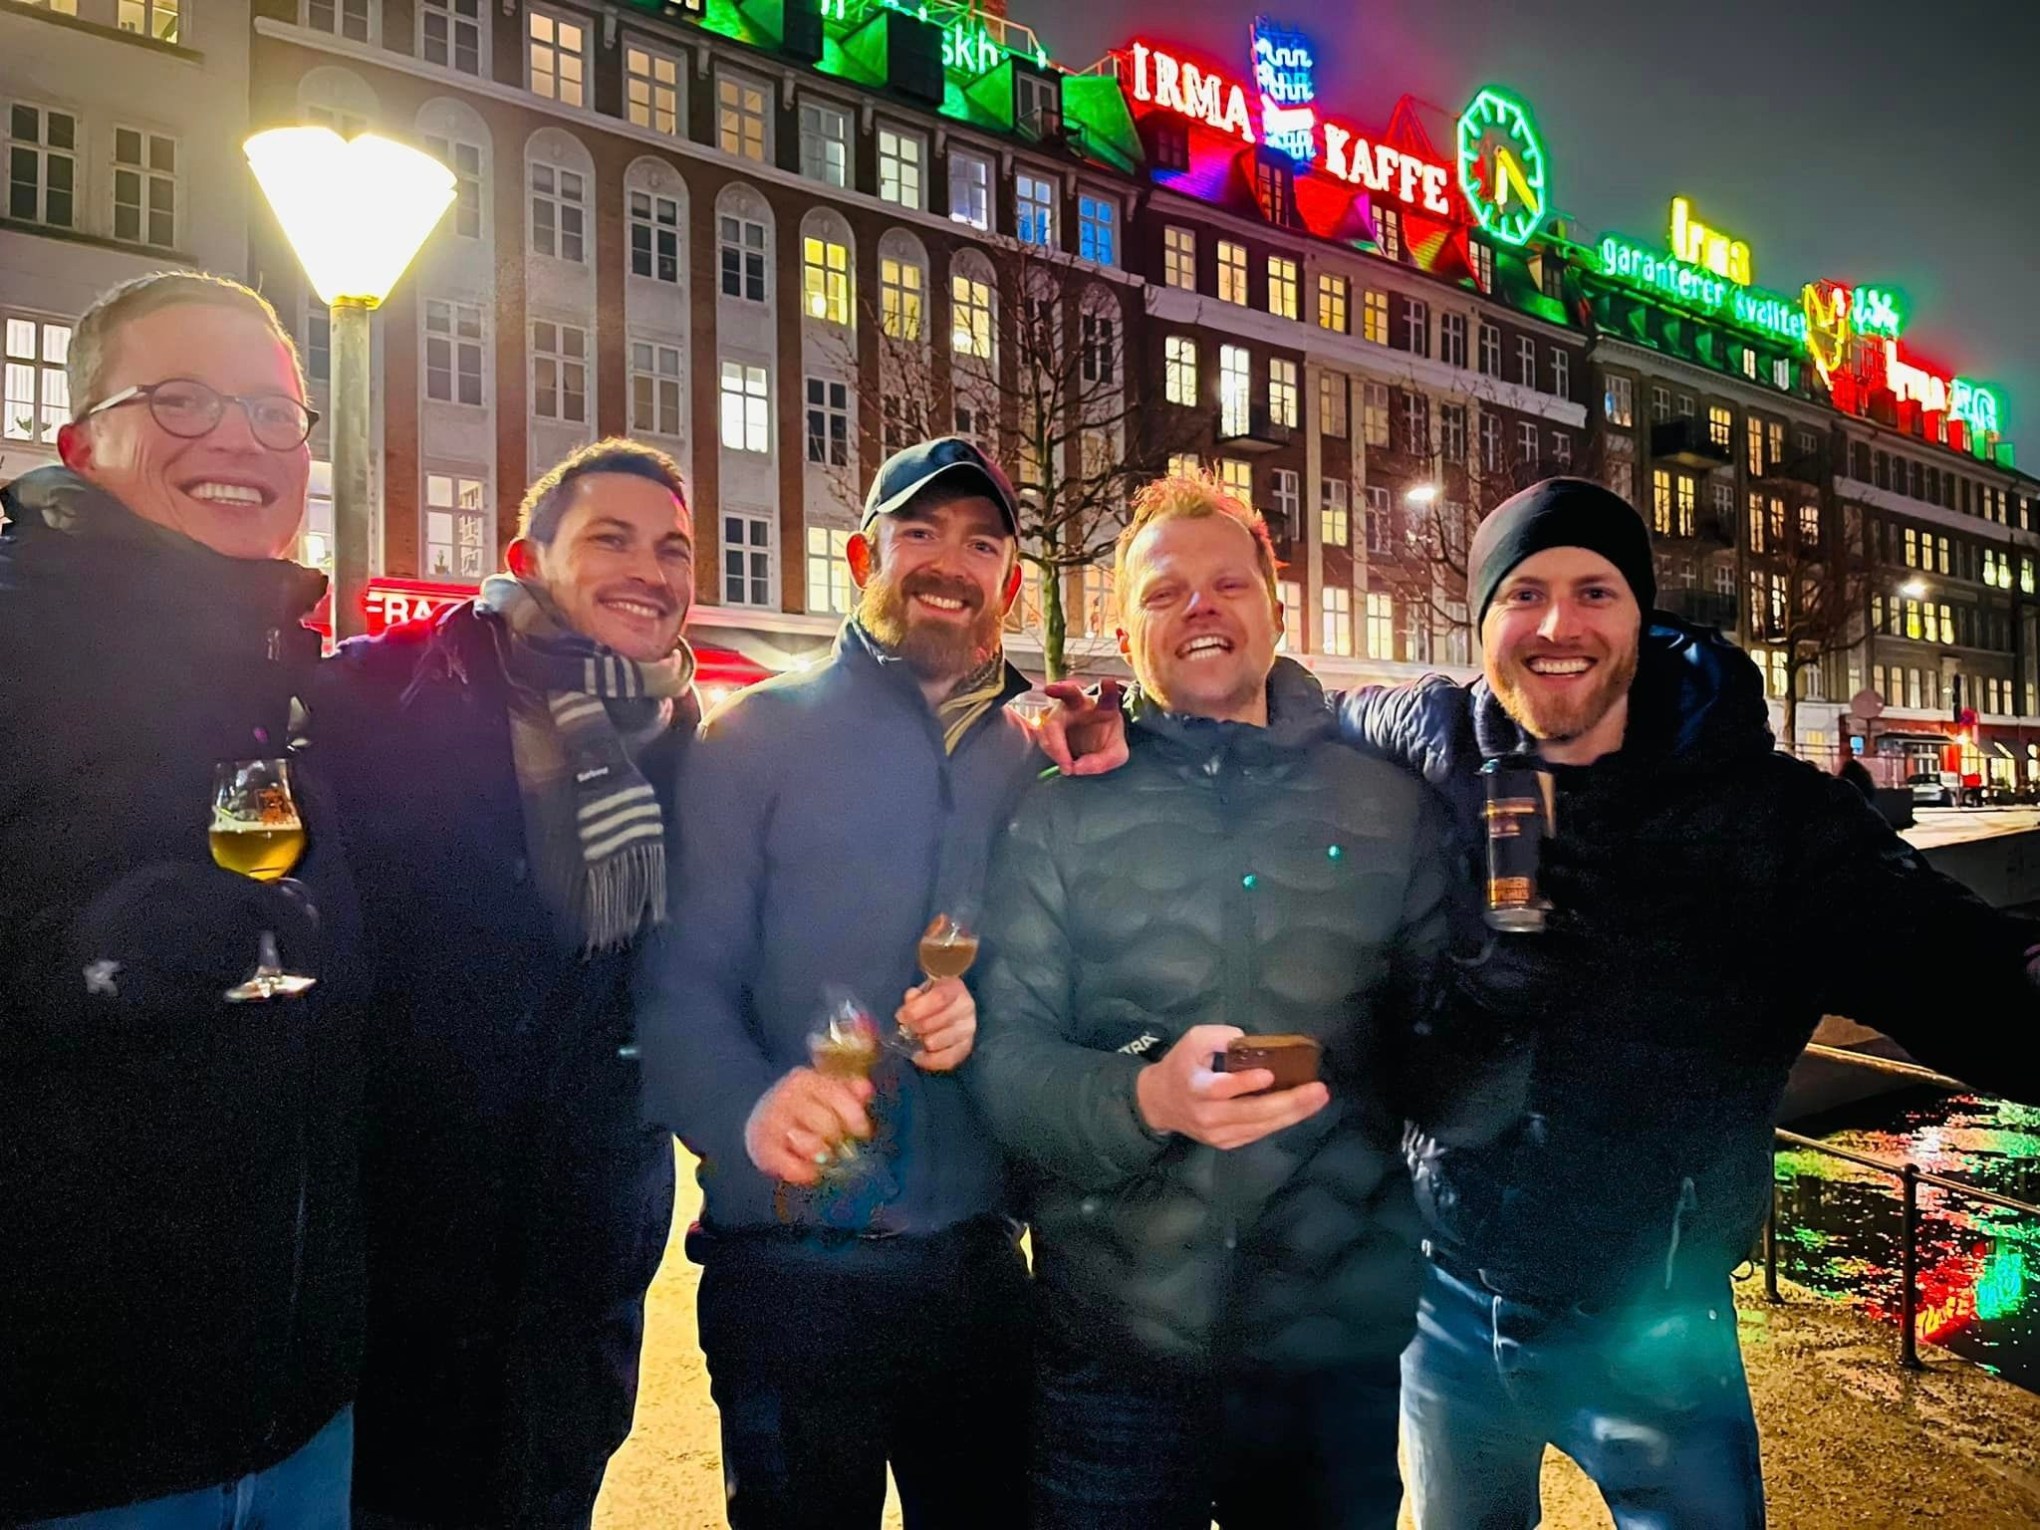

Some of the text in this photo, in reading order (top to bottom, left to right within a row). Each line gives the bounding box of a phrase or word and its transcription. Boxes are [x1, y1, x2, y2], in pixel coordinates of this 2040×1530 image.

[1132, 42, 1449, 214] IRMA KAFFE
[1602, 237, 1725, 308] garanterer
